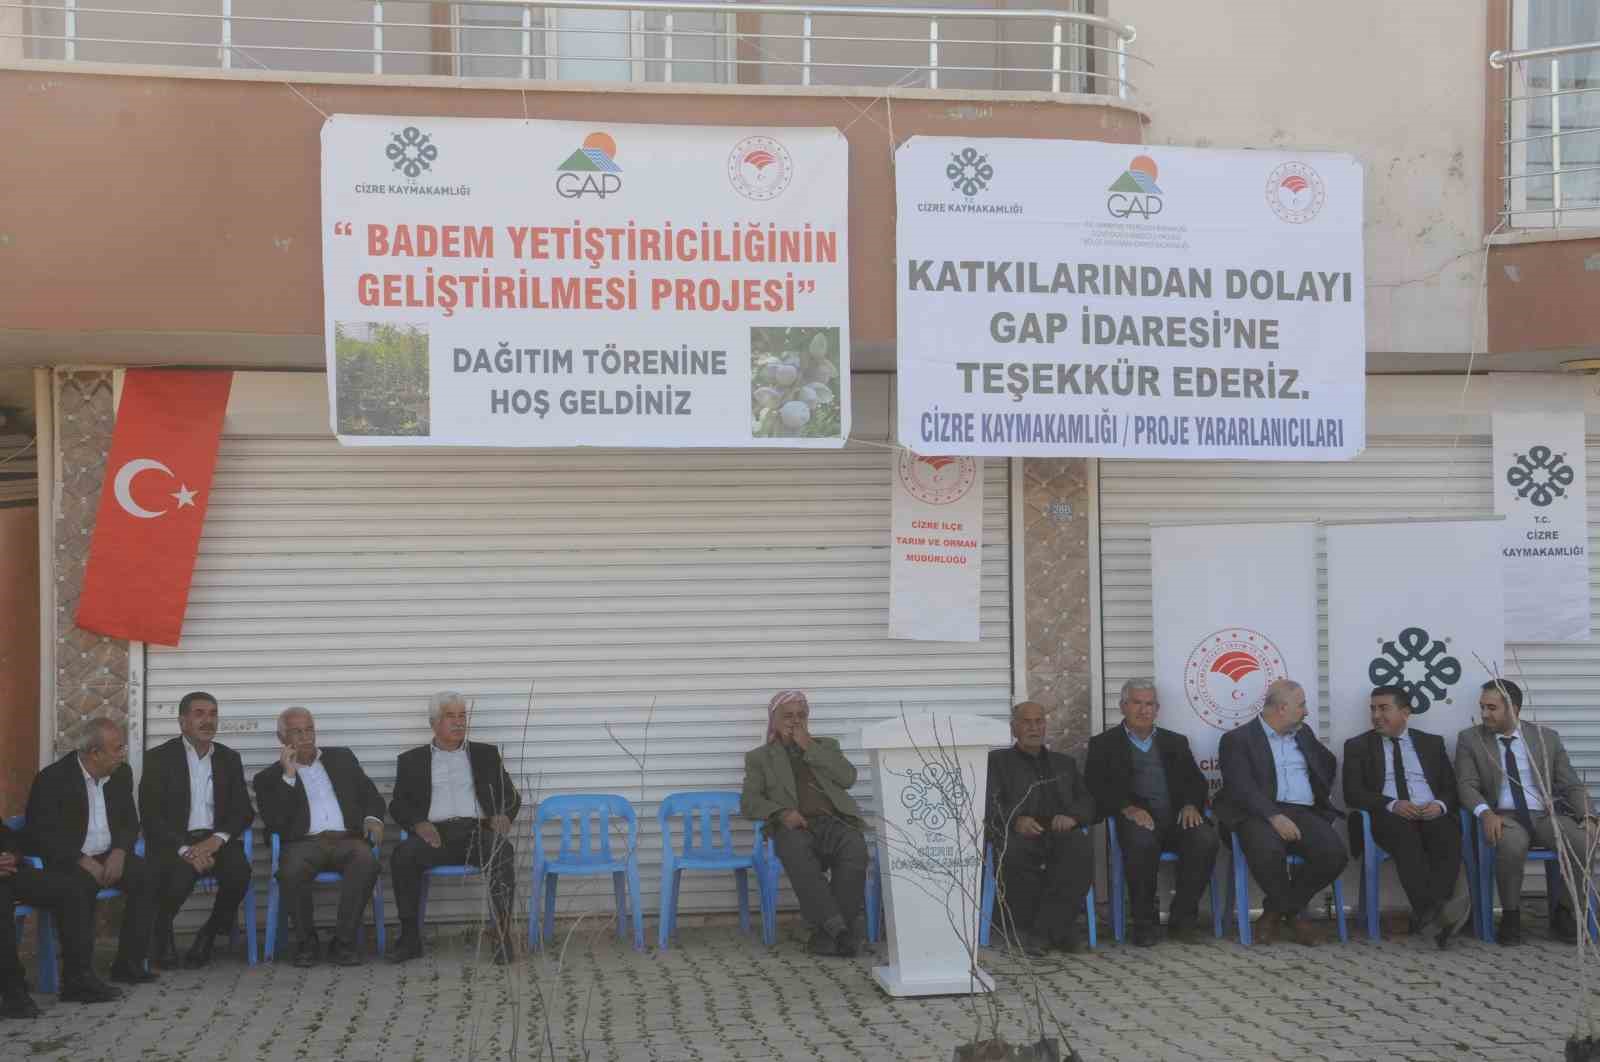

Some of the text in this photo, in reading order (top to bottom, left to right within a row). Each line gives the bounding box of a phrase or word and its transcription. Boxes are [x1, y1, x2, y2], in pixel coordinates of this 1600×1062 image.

[355, 182, 386, 194] CİZRE
[556, 172, 622, 199] GAP
[917, 202, 946, 213] CİZRE
[1107, 193, 1163, 220] GAP
[367, 223, 494, 259] BADEM
[507, 220, 837, 268] YETİŞTİRİCİLİĞİNİN
[358, 267, 637, 317] GELİŞTİRİLMESİ
[908, 259, 1352, 303] KATKILARINDAN DOLAYI
[989, 311, 1068, 344] GAP
[453, 342, 728, 375] DAĞITIM TÖRENİNE
[956, 358, 1310, 402] TEŞEKKÜR EDERİZ.
[490, 383, 692, 419] HOŞ GELDİNİZ
[920, 405, 975, 443] CİZRE
[981, 408, 1118, 445] KAYMAKAMLIĞI
[1134, 415, 1190, 446] PROJE
[1194, 417, 1344, 448] YARARLANICILARI
[1526, 529, 1560, 541] CİZRE
[1534, 516, 1551, 524] T.C.
[928, 538, 940, 546] VE
